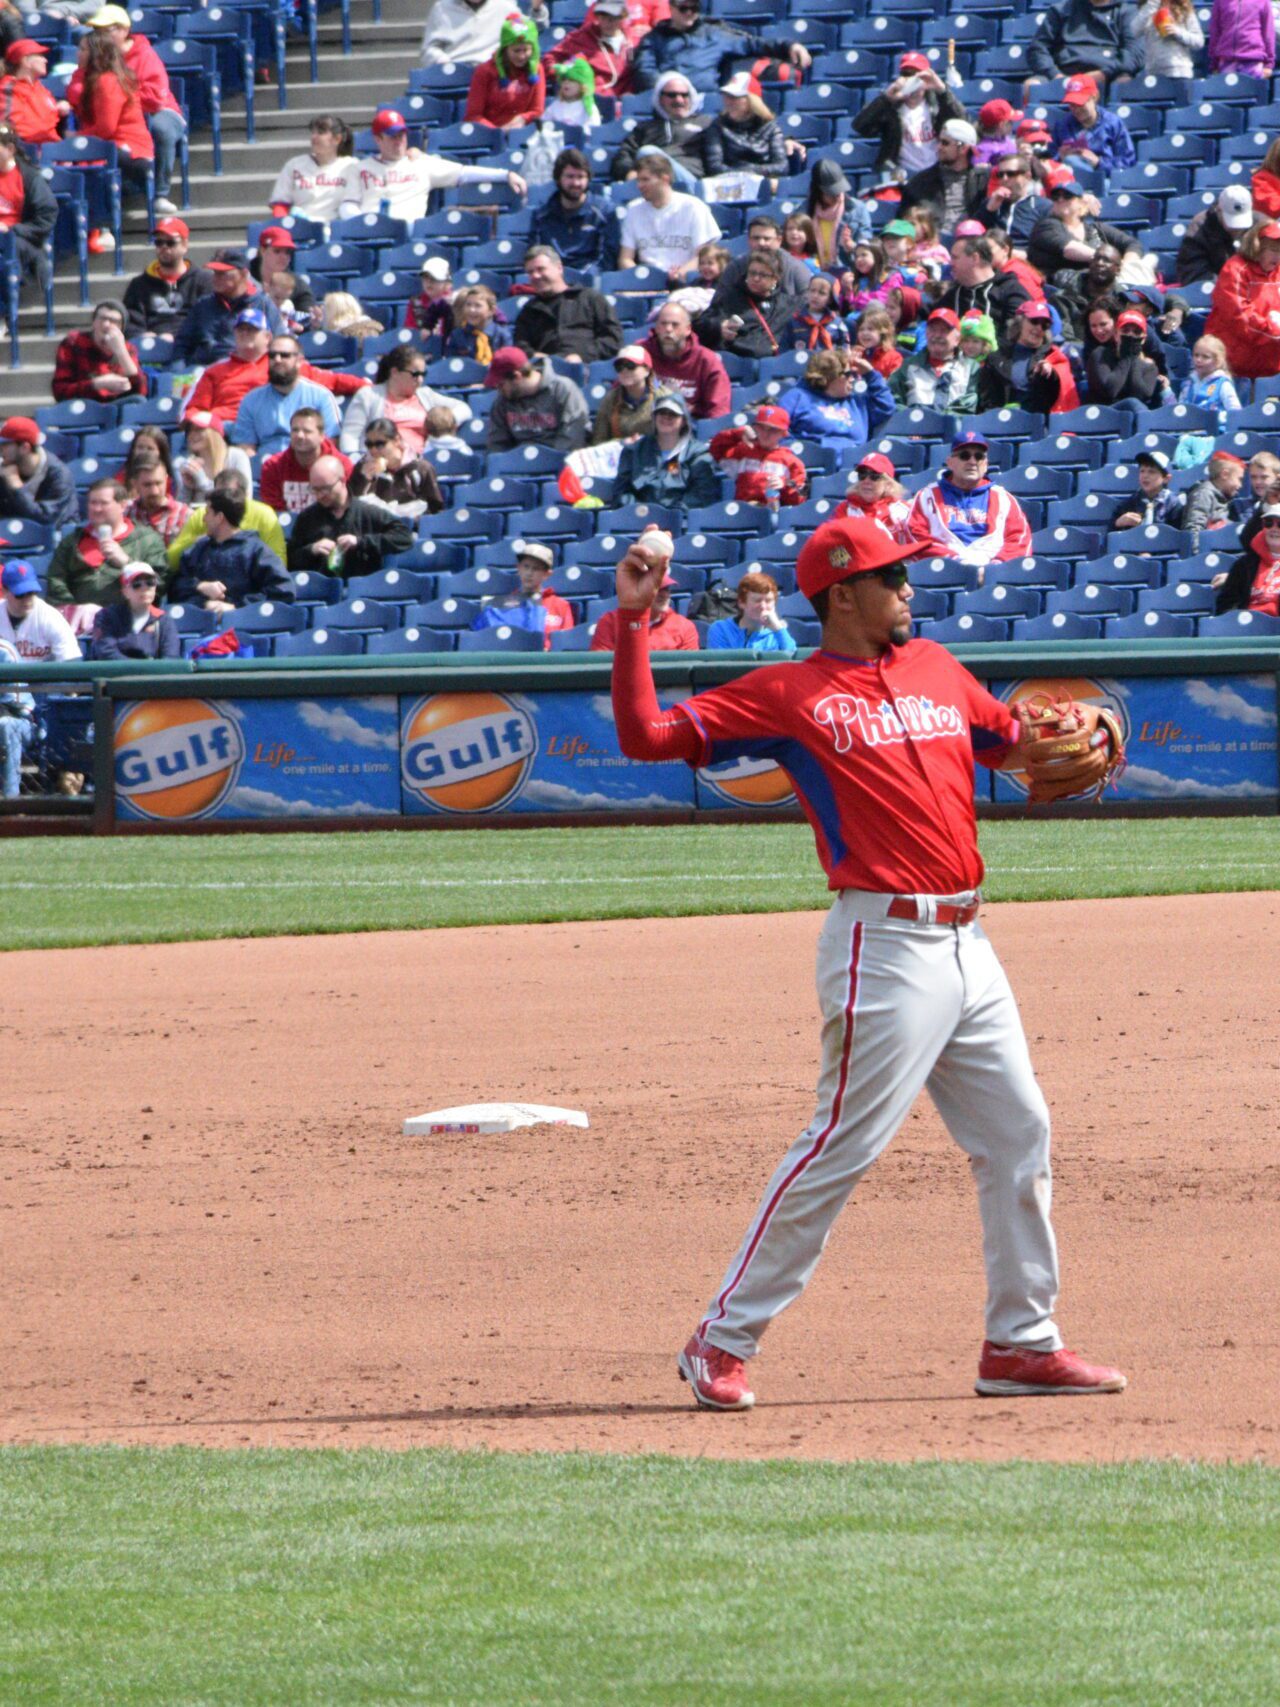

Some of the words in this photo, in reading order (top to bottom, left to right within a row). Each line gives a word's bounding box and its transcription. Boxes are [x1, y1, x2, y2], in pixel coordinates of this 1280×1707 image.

[814, 693, 966, 753] Phillies
[116, 726, 230, 787] Gulf
[405, 719, 523, 781] Gulf
[577, 757, 600, 767] one
[603, 756, 629, 767] mile
[1169, 743, 1193, 753] one
[1196, 741, 1222, 752] mile
[1225, 740, 1236, 752] at
[283, 764, 306, 775] one
[310, 762, 335, 773] mile
[338, 762, 349, 773] at
